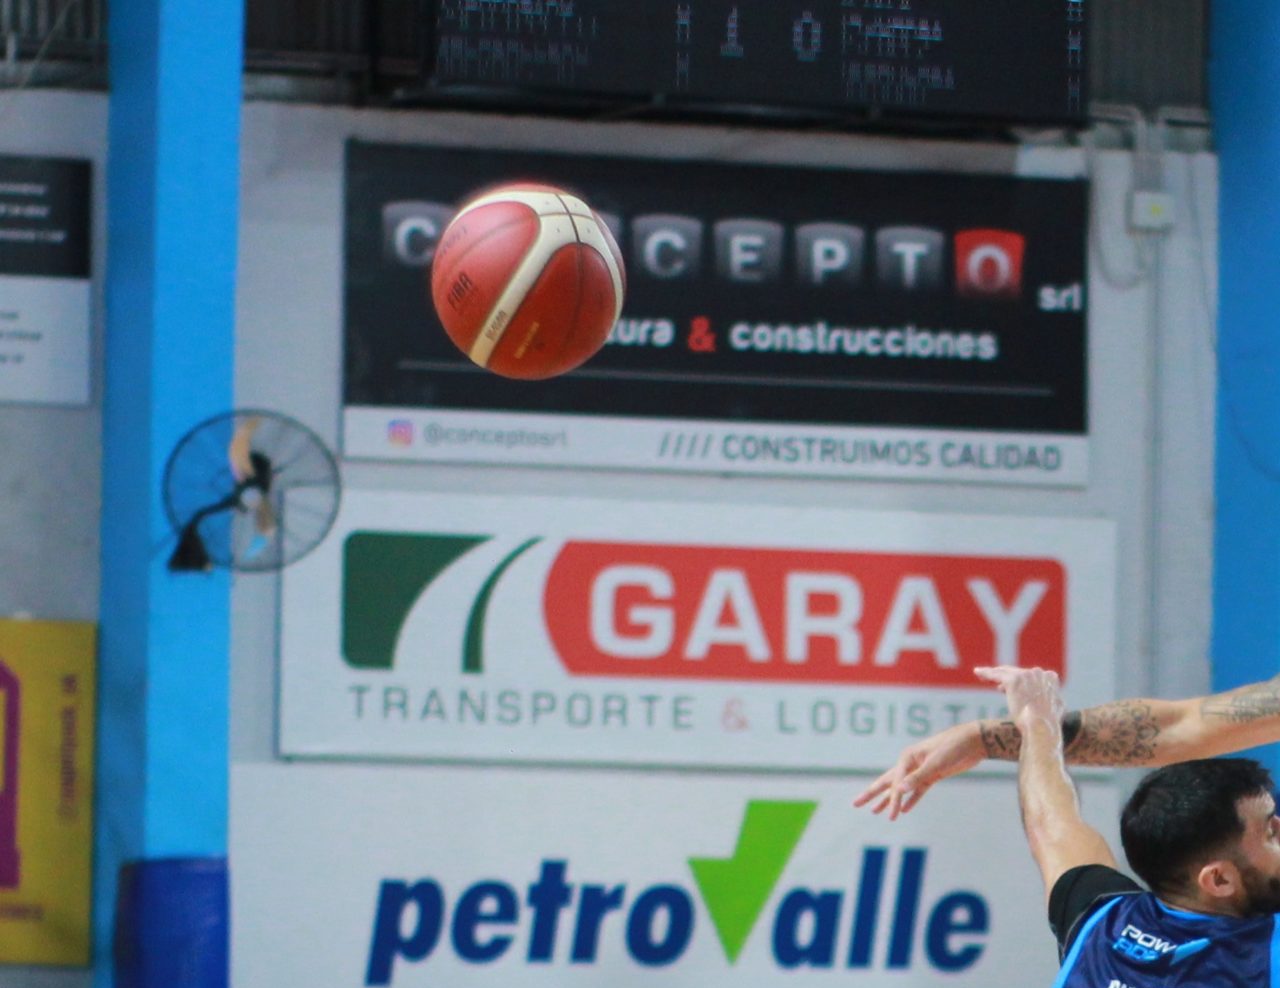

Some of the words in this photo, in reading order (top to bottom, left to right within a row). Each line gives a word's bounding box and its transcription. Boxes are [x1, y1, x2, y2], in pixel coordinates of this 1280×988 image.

[1037, 284, 1083, 312] srl
[687, 316, 717, 353] &
[729, 318, 999, 361] construcciones
[722, 434, 932, 467] CONSTRUIMOS
[940, 441, 1063, 471] CALIDAD
[589, 563, 1049, 669] GARAY
[348, 685, 697, 730] TRANSPORTE
[1120, 924, 1178, 953] POW
